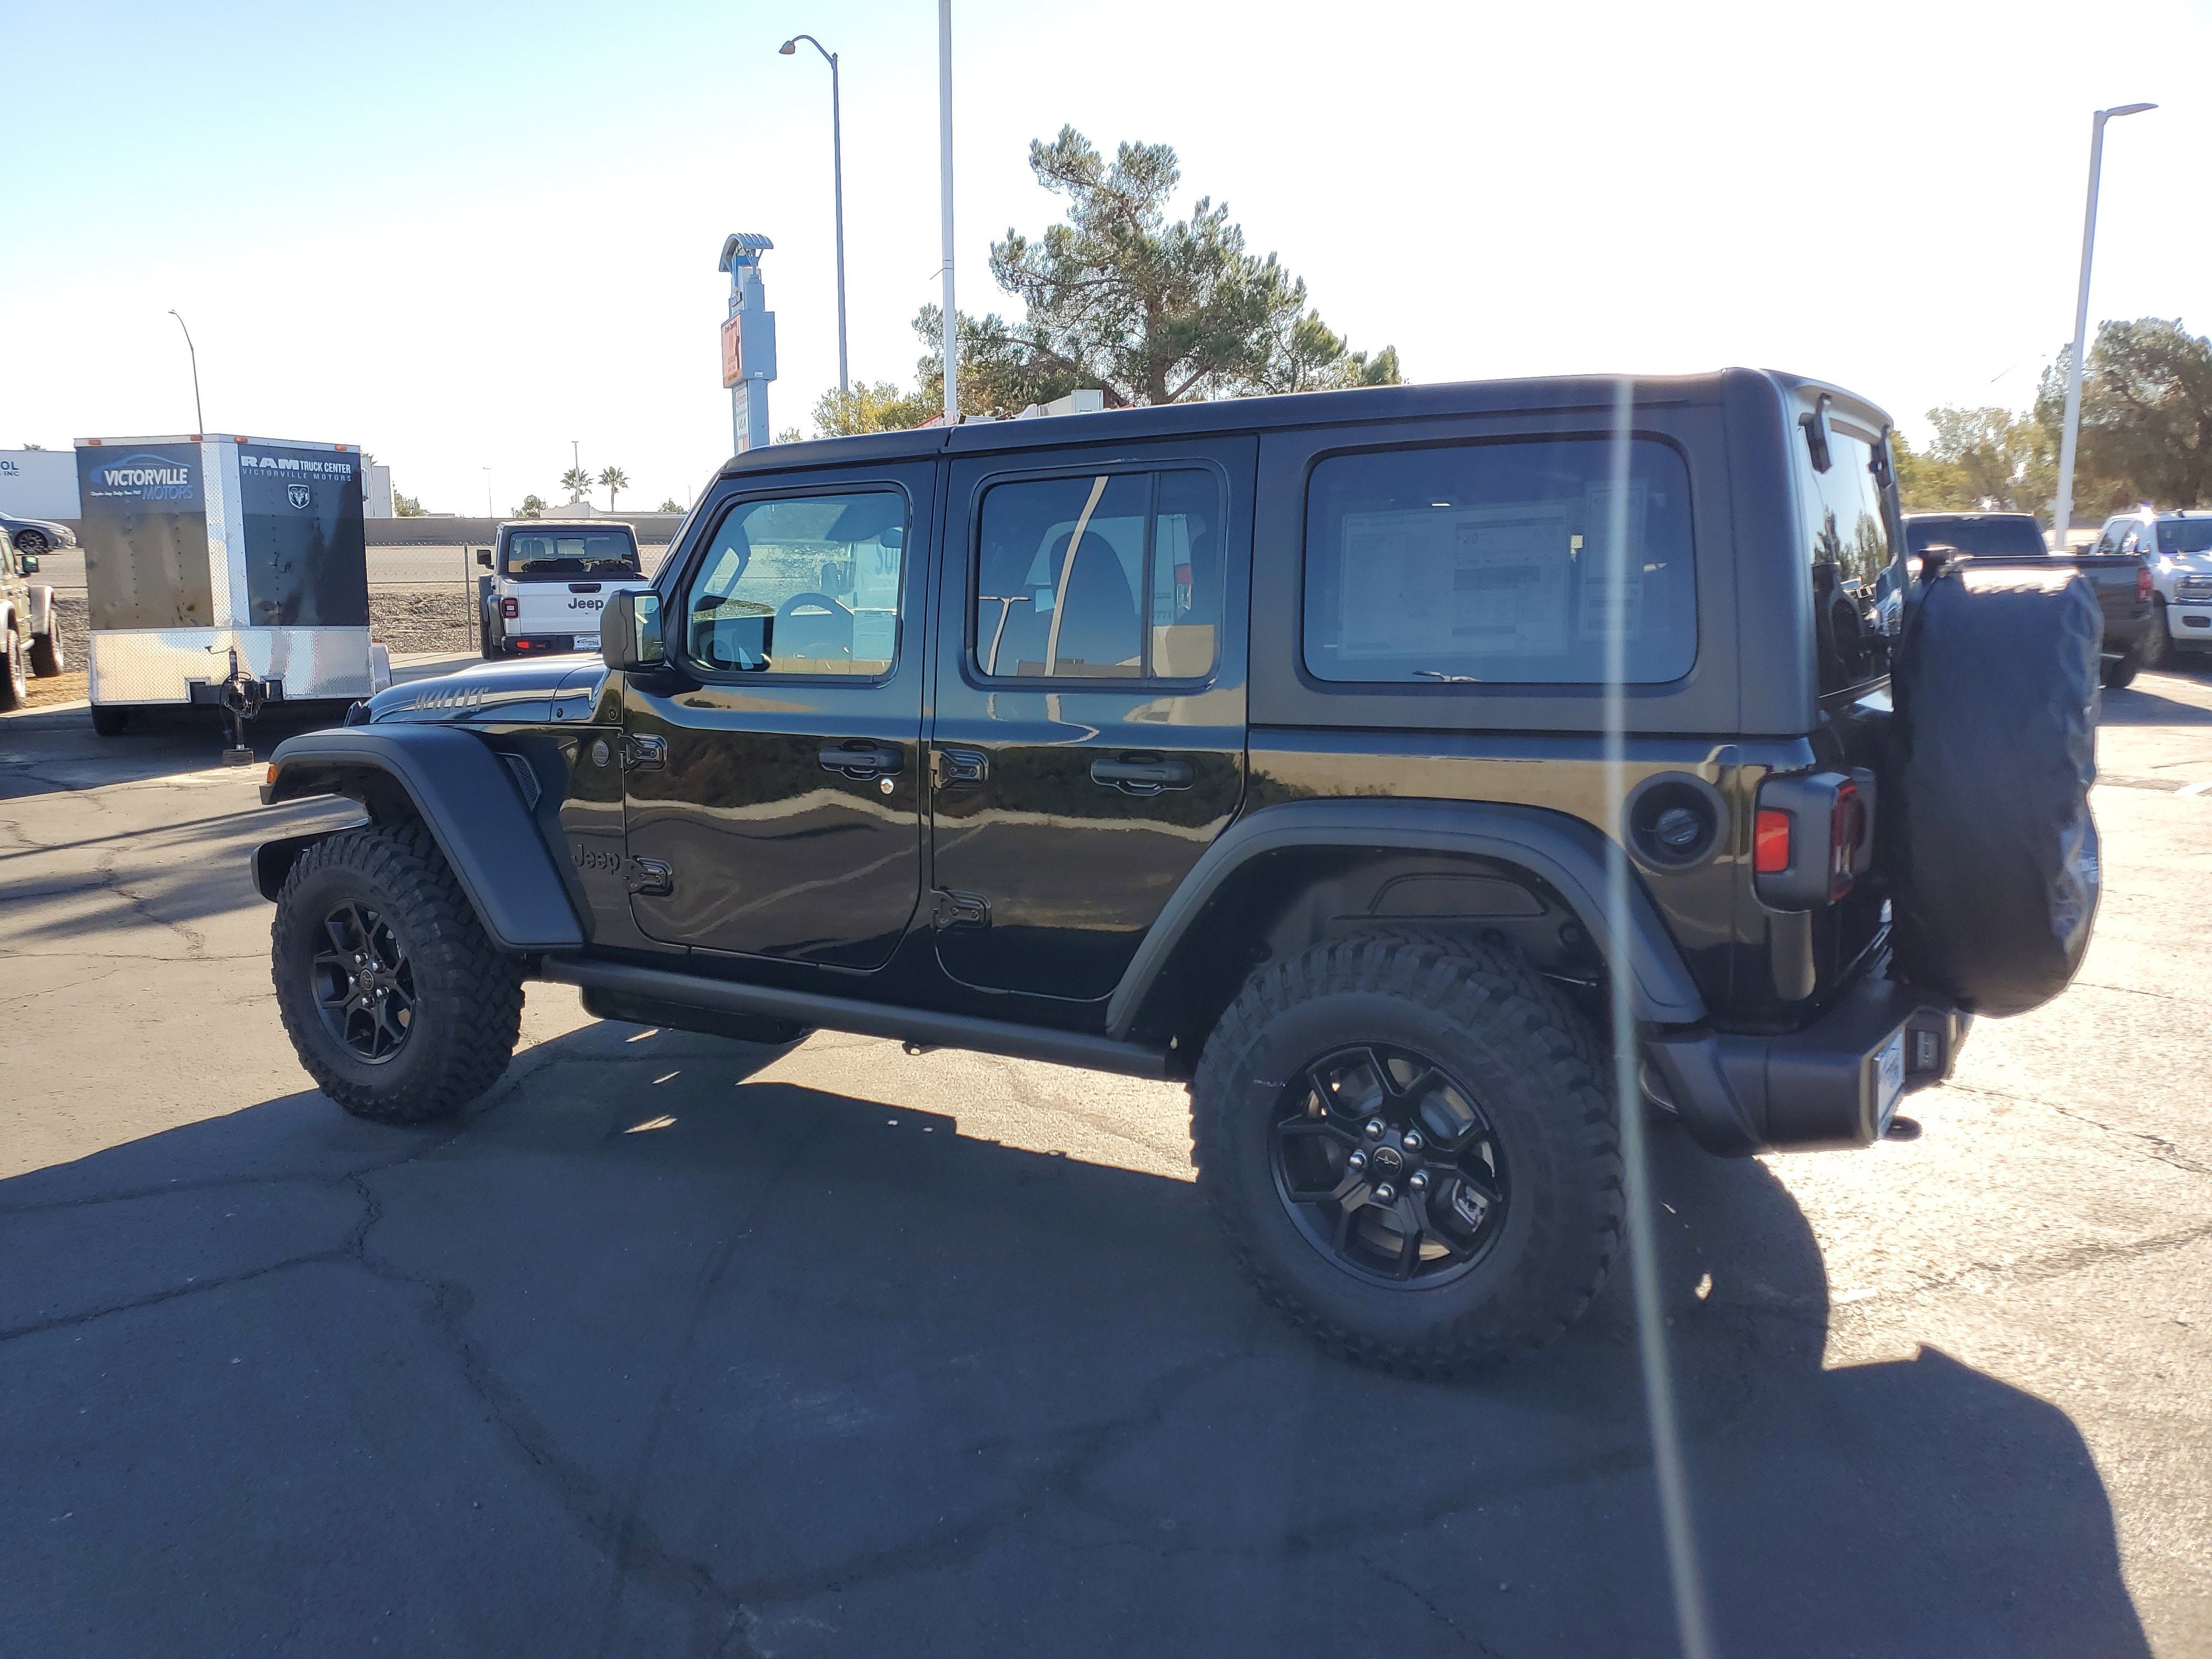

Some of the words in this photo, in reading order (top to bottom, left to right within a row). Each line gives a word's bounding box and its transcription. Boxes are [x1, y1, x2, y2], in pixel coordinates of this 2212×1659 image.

[241, 455, 299, 470] RAM
[299, 460, 323, 472] TRUCK
[324, 462, 351, 474] CENTER
[104, 468, 188, 487] VICTORVILLE
[242, 468, 308, 479] VICTORVILLE
[313, 473, 352, 482] MOTORS
[143, 486, 193, 500] MOTORS
[568, 597, 604, 611] Jeep
[571, 844, 620, 876] Jeep
